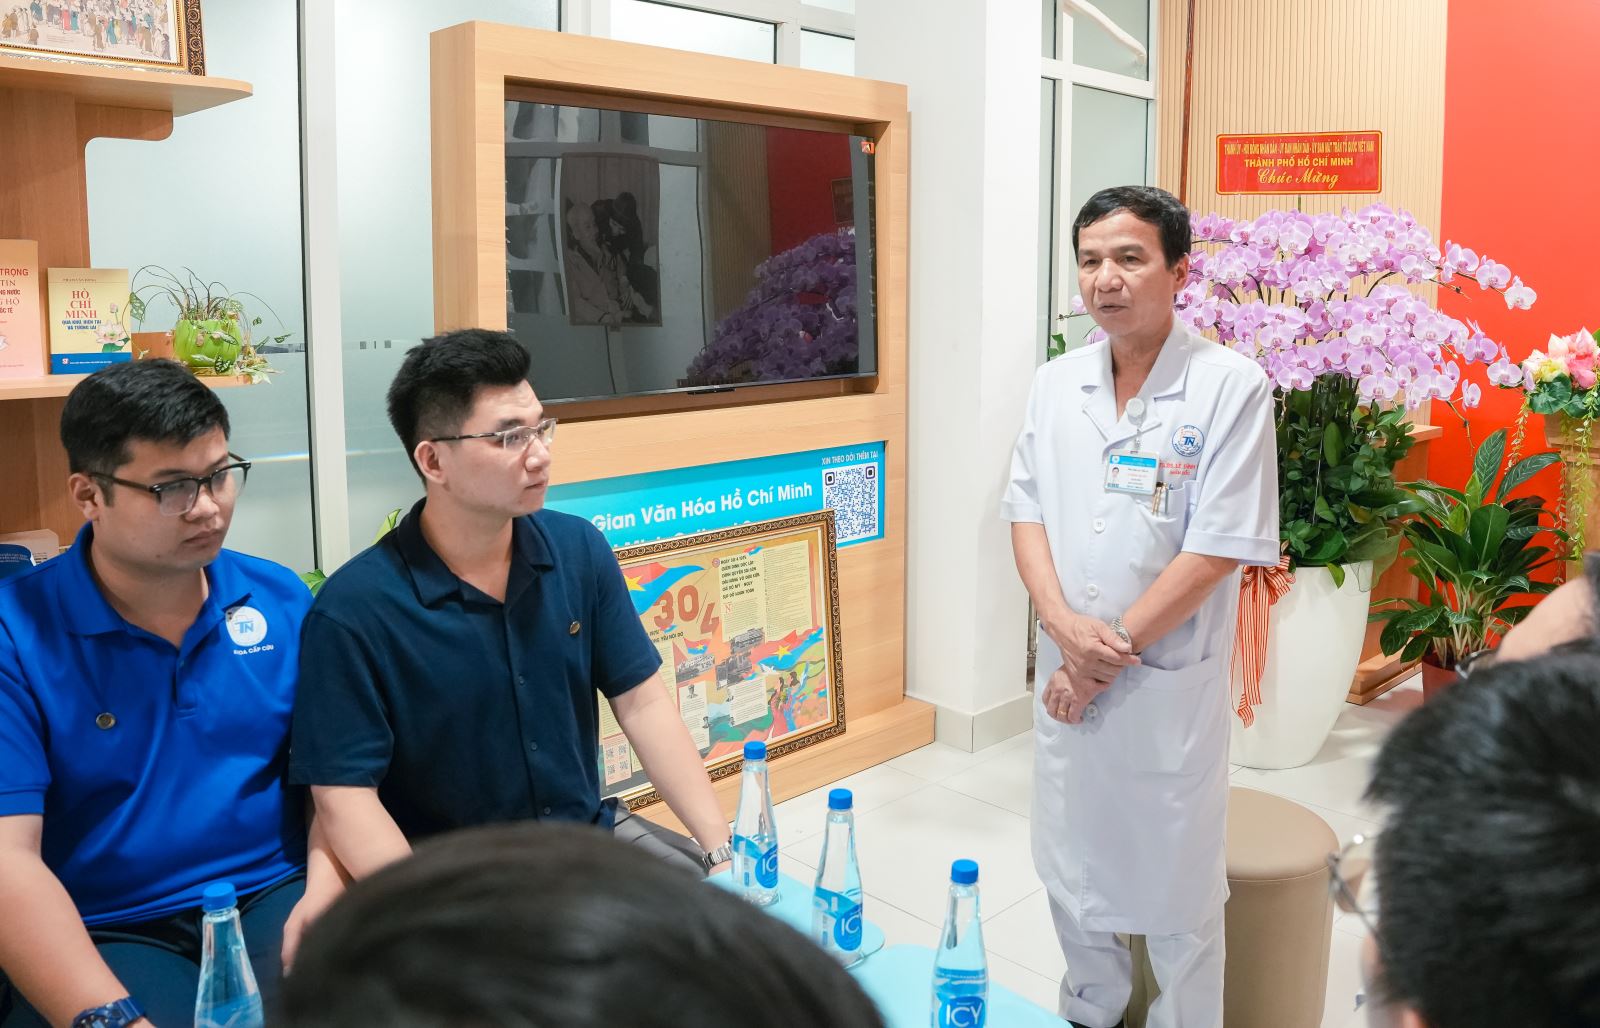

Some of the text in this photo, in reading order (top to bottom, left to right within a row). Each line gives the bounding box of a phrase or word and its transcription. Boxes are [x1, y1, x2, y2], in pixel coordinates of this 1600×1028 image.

[1331, 157, 1353, 166] MINH
[1258, 168, 1293, 184] Chúc
[70, 298, 91, 309] CHÍ
[65, 310, 97, 318] MINH
[821, 457, 831, 466] XIN
[832, 455, 845, 464] THEO
[591, 482, 814, 532] Gian Văn Hóa Hồ Chí Minh
[234, 620, 254, 634] TN
[945, 1002, 983, 1027] ICY
